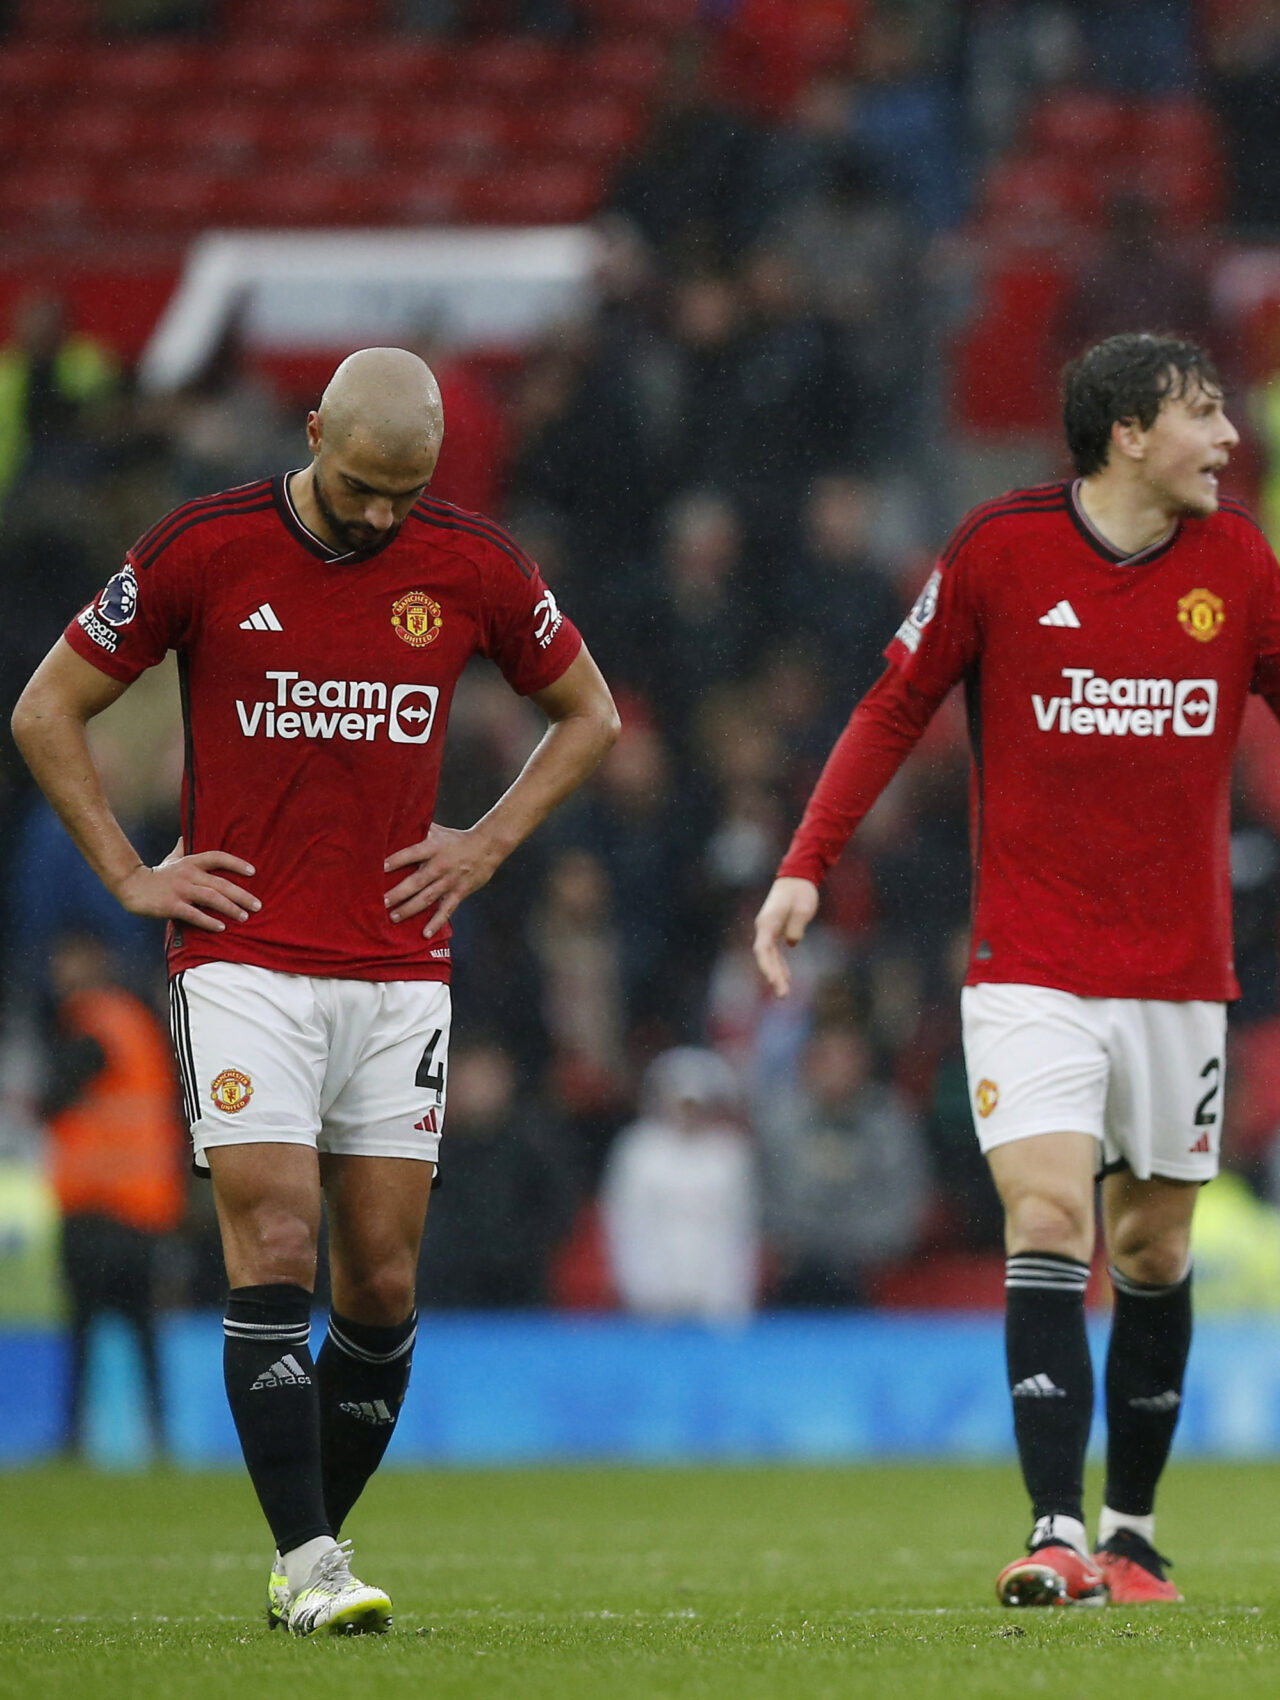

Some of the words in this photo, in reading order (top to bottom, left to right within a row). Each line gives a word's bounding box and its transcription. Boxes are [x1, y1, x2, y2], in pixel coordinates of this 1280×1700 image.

[396, 595, 438, 614] MANCHESTER
[403, 633, 433, 644] UNITED
[266, 671, 388, 710] Team
[1061, 668, 1174, 707] Team
[235, 700, 386, 741] Viewer
[1031, 694, 1172, 737] Viewer
[415, 1028, 444, 1104] 4
[1194, 1057, 1219, 1125] 2
[250, 1375, 312, 1391] adidas
